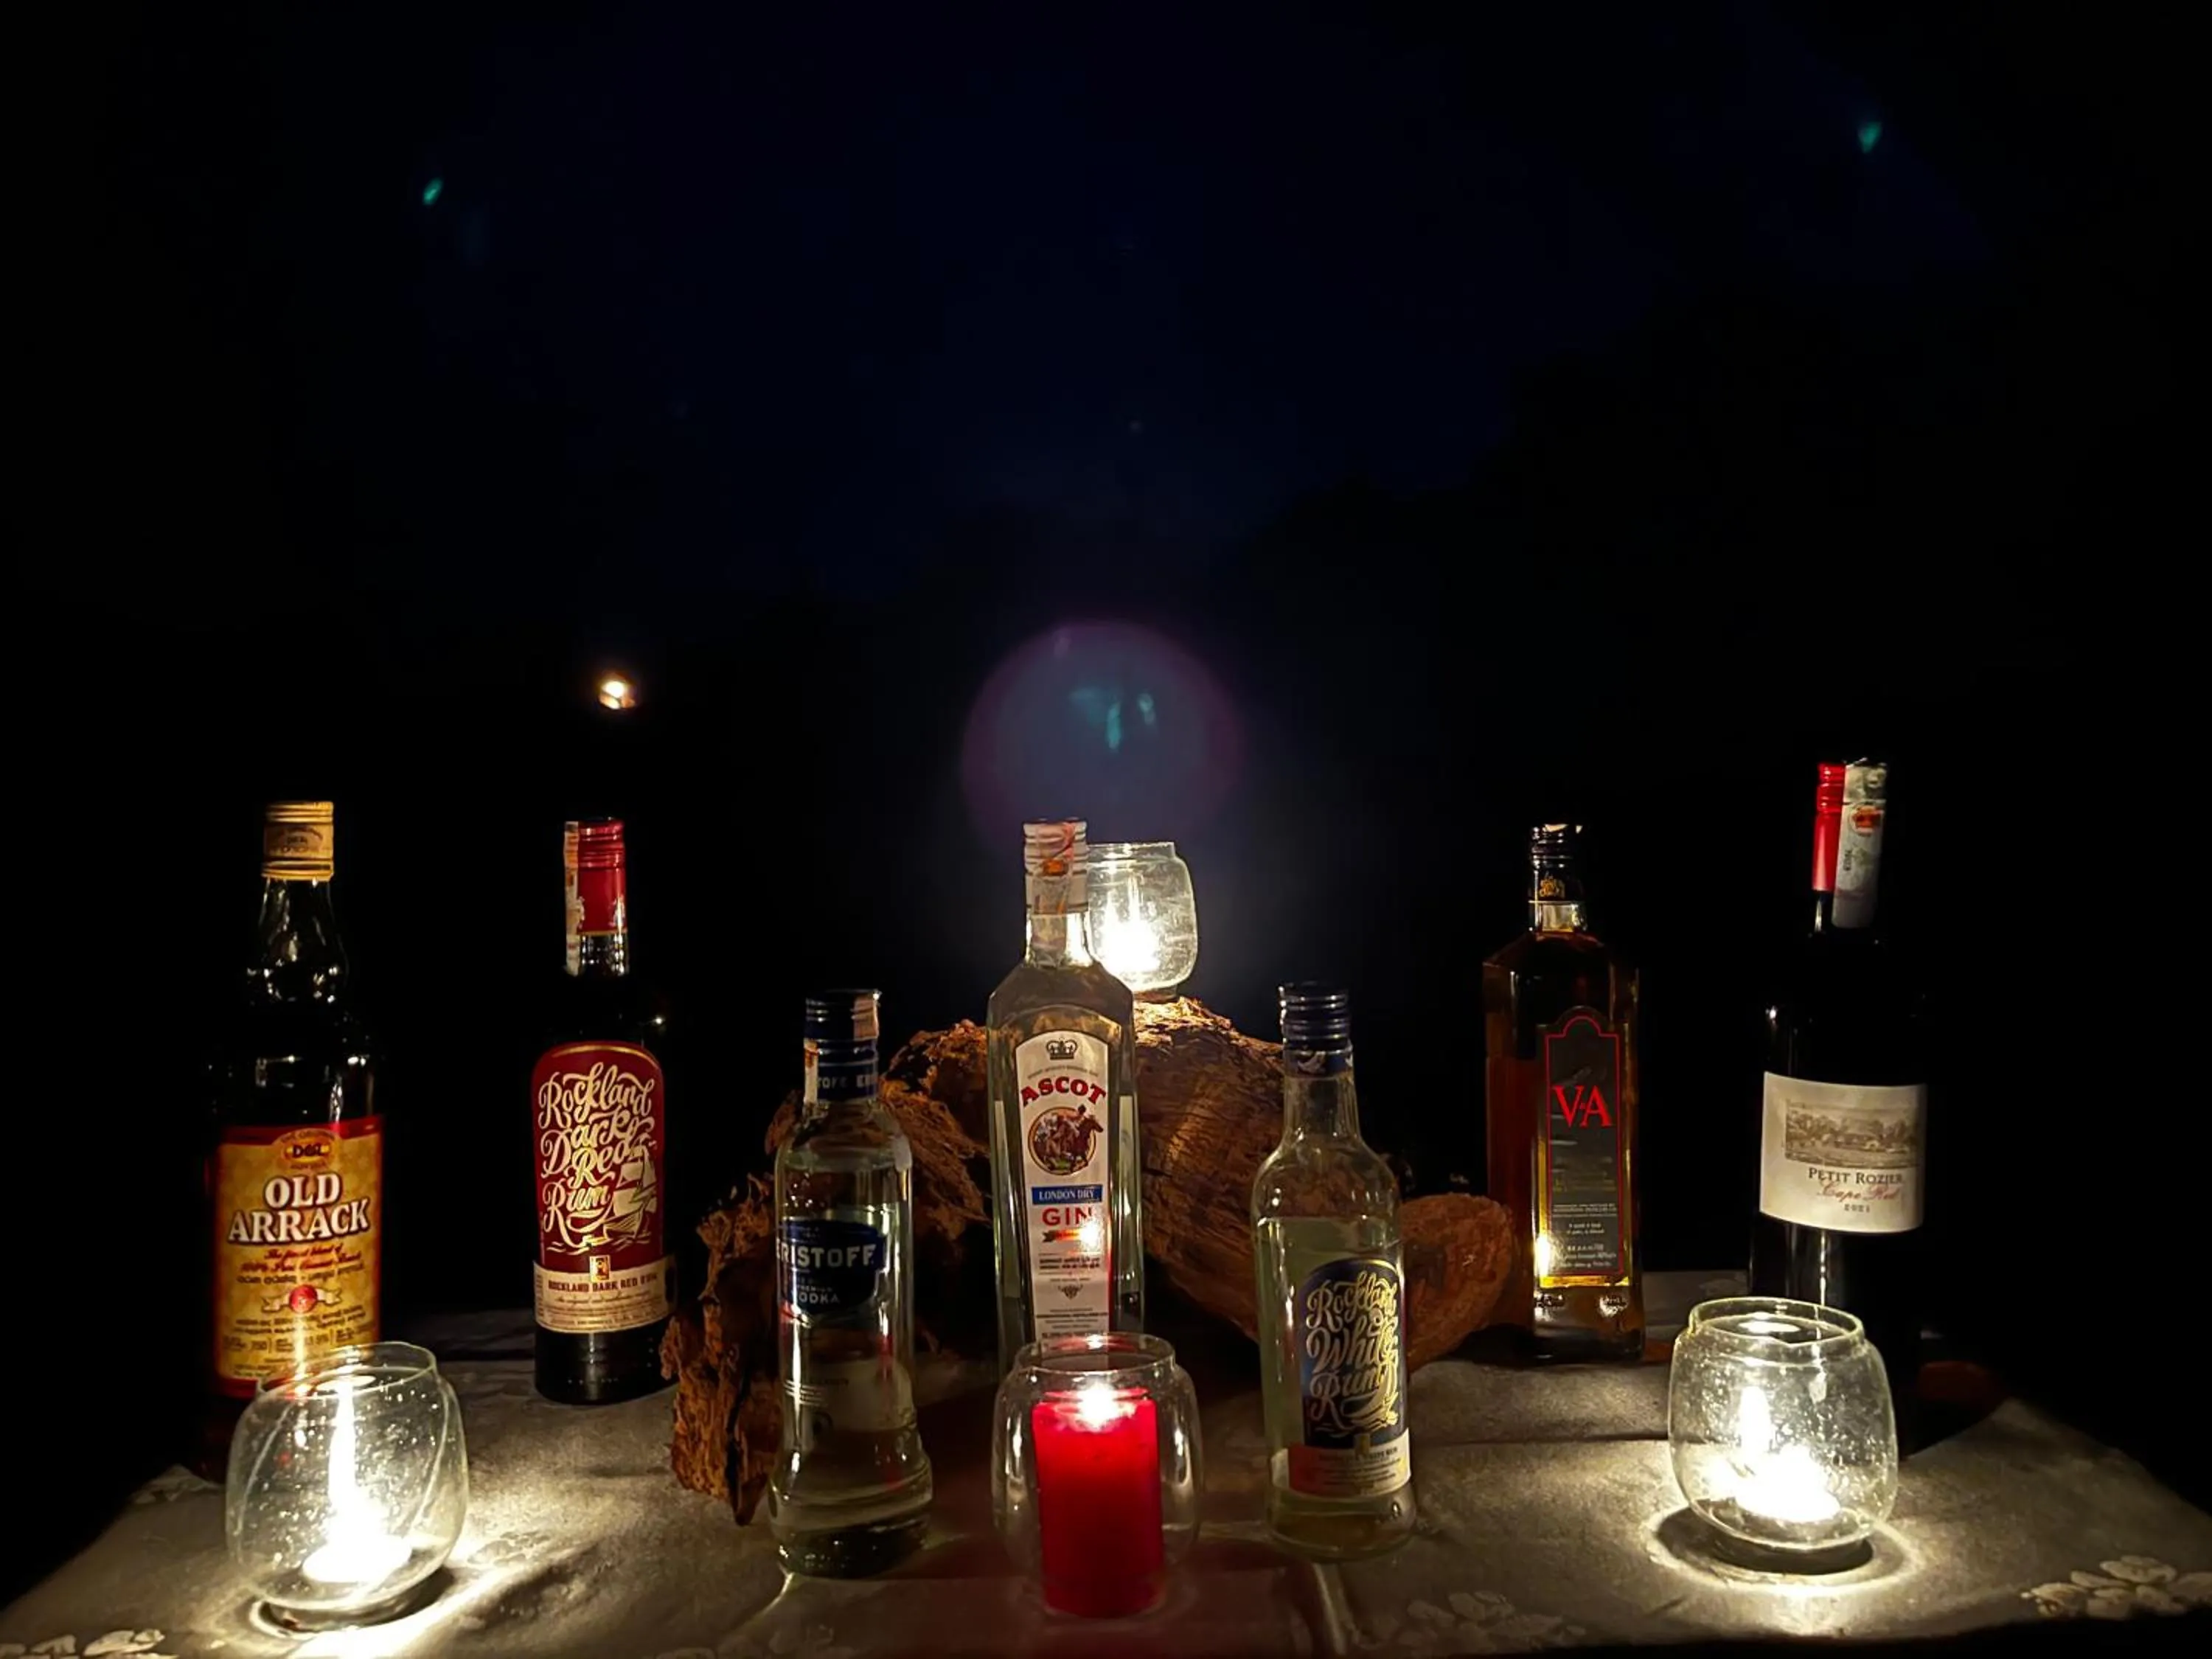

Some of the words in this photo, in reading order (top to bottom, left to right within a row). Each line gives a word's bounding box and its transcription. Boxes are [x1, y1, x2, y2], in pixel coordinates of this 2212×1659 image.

[538, 1062, 655, 1130] Rockland
[1020, 1076, 1106, 1107] ASCOT
[540, 1105, 630, 1178] Dark
[563, 1116, 655, 1190] Red
[265, 1172, 341, 1208] OLD
[1809, 1167, 1851, 1183] PETIT
[542, 1178, 612, 1248] Rum
[1039, 1190, 1076, 1201] LONDON
[1077, 1189, 1095, 1200] DRY
[227, 1198, 369, 1243] ARRACK
[1042, 1206, 1093, 1226] GIN
[548, 1279, 590, 1293] ROCKLAND
[592, 1280, 619, 1293] DARK
[620, 1277, 639, 1289] RED
[794, 1292, 841, 1305] ODKA
[1310, 1368, 1384, 1427] Rum
